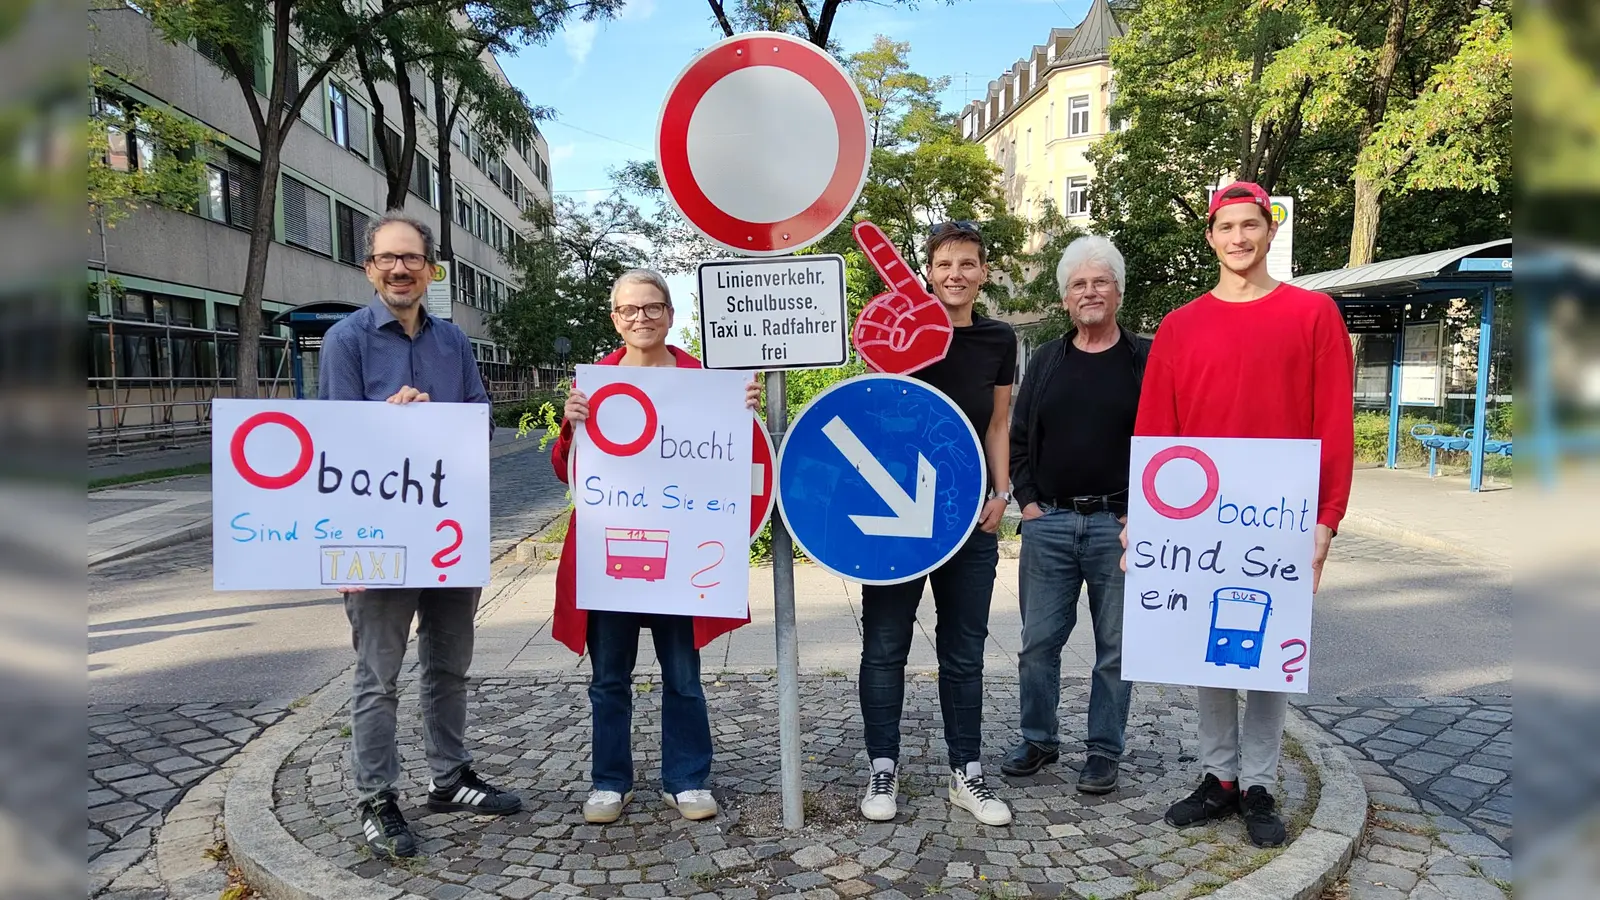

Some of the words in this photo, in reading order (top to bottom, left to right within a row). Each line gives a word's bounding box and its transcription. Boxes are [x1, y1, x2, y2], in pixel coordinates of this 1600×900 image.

[717, 268, 825, 288] Linienverkehr,
[727, 294, 818, 313] Schulbusse,
[709, 321, 738, 338] Taxi
[744, 323, 757, 337] u.
[763, 317, 837, 336] Radfahrer
[762, 343, 787, 360] frei
[584, 475, 648, 508] Sind
[661, 485, 694, 511] Sie
[706, 497, 736, 514] ein
[230, 512, 299, 543] Sind
[314, 518, 344, 540] Sie
[357, 526, 385, 540] ein
[627, 531, 648, 541] 112
[324, 550, 401, 581] TAXI
[431, 519, 463, 582] ?
[1242, 545, 1300, 582] Sie
[690, 541, 725, 599] ?
[1140, 588, 1188, 612] ein
[1231, 591, 1257, 602] BUS
[1280, 638, 1308, 683] ?
